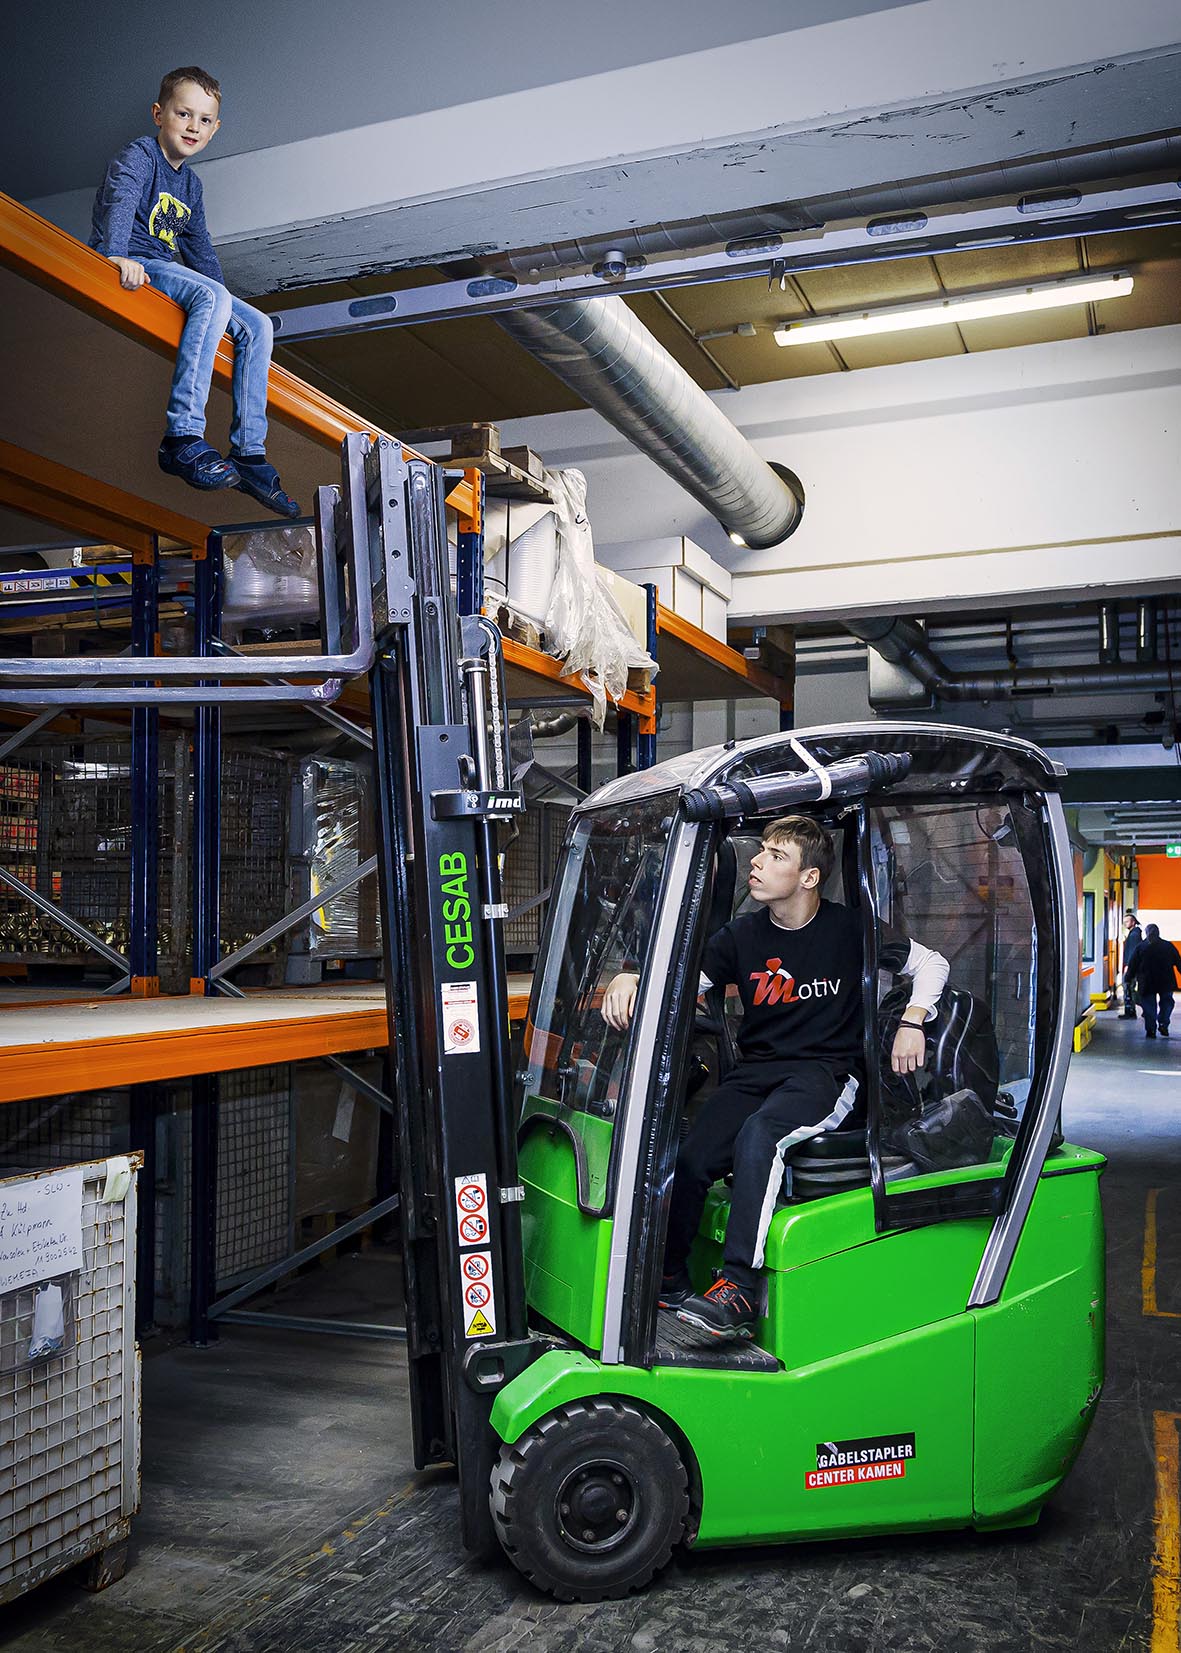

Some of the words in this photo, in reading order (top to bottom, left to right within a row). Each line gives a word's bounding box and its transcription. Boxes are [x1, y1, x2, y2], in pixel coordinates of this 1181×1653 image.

[439, 851, 475, 970] CESAB
[749, 968, 841, 1006] Motiv
[819, 1444, 913, 1468] GABELSTAPLER
[809, 1468, 855, 1487] CENTER
[858, 1462, 902, 1480] KAMEN
